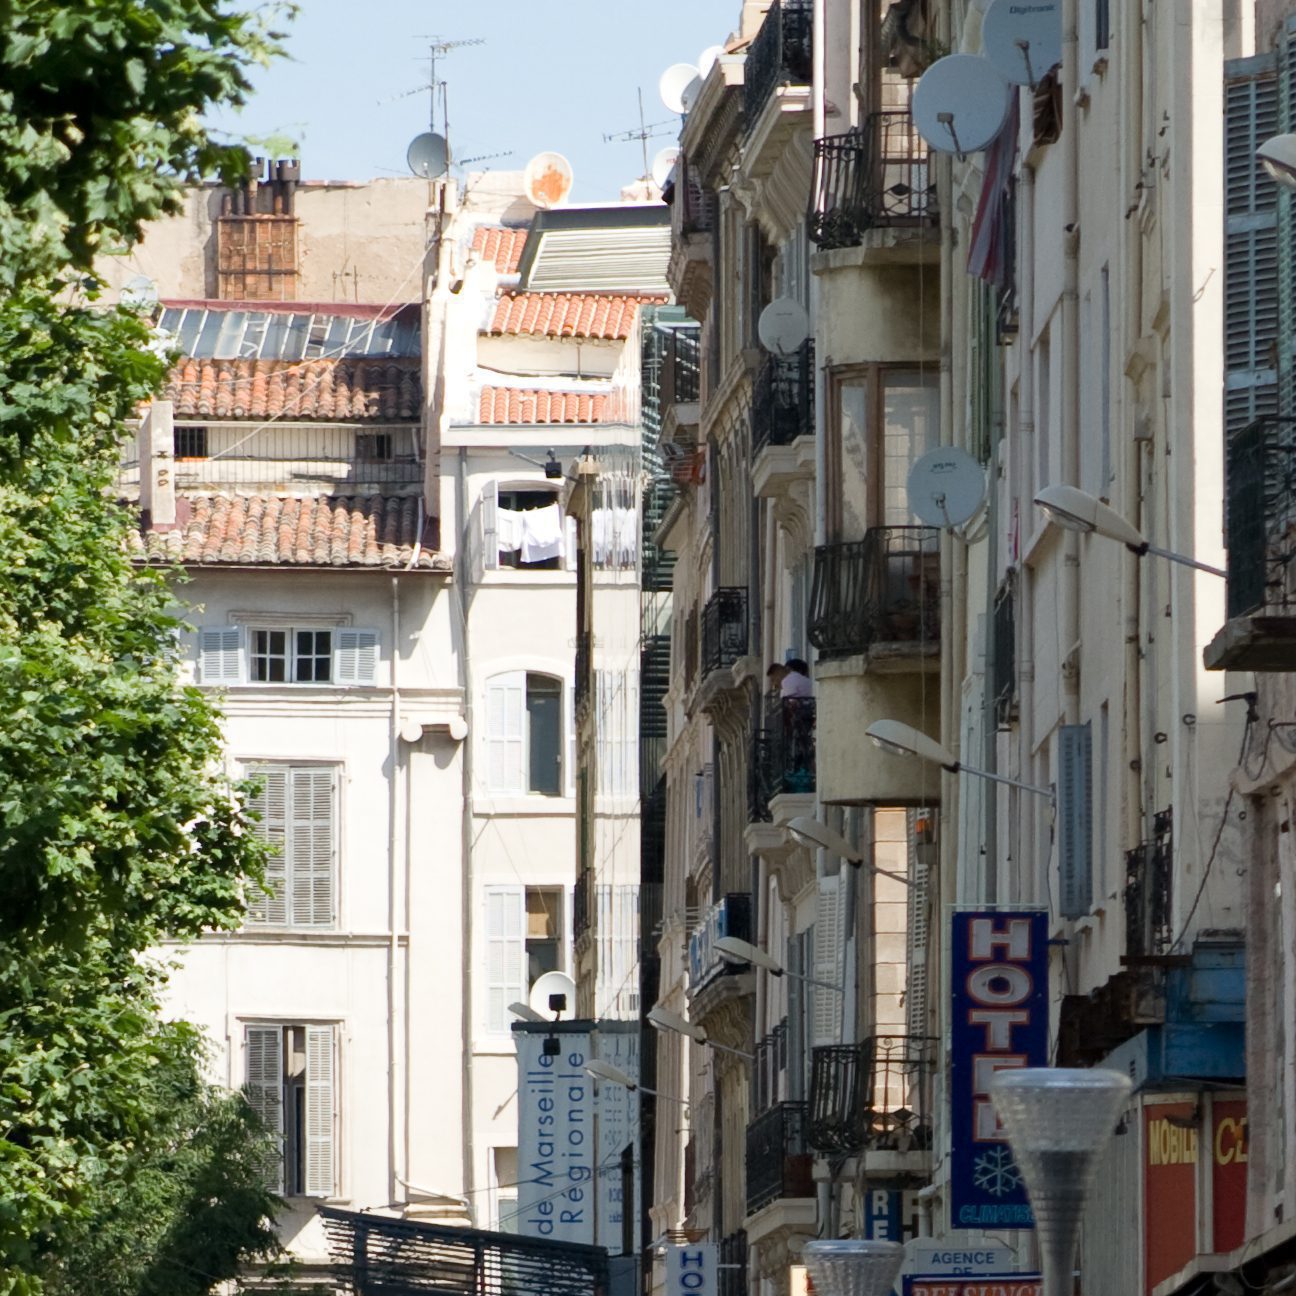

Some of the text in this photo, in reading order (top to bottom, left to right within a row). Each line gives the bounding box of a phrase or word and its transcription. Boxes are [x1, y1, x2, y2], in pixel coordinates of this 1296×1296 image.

[527, 1052, 554, 1235] de Marseille
[557, 1052, 592, 1224] Régionale
[931, 1252, 995, 1265] AGENCE
